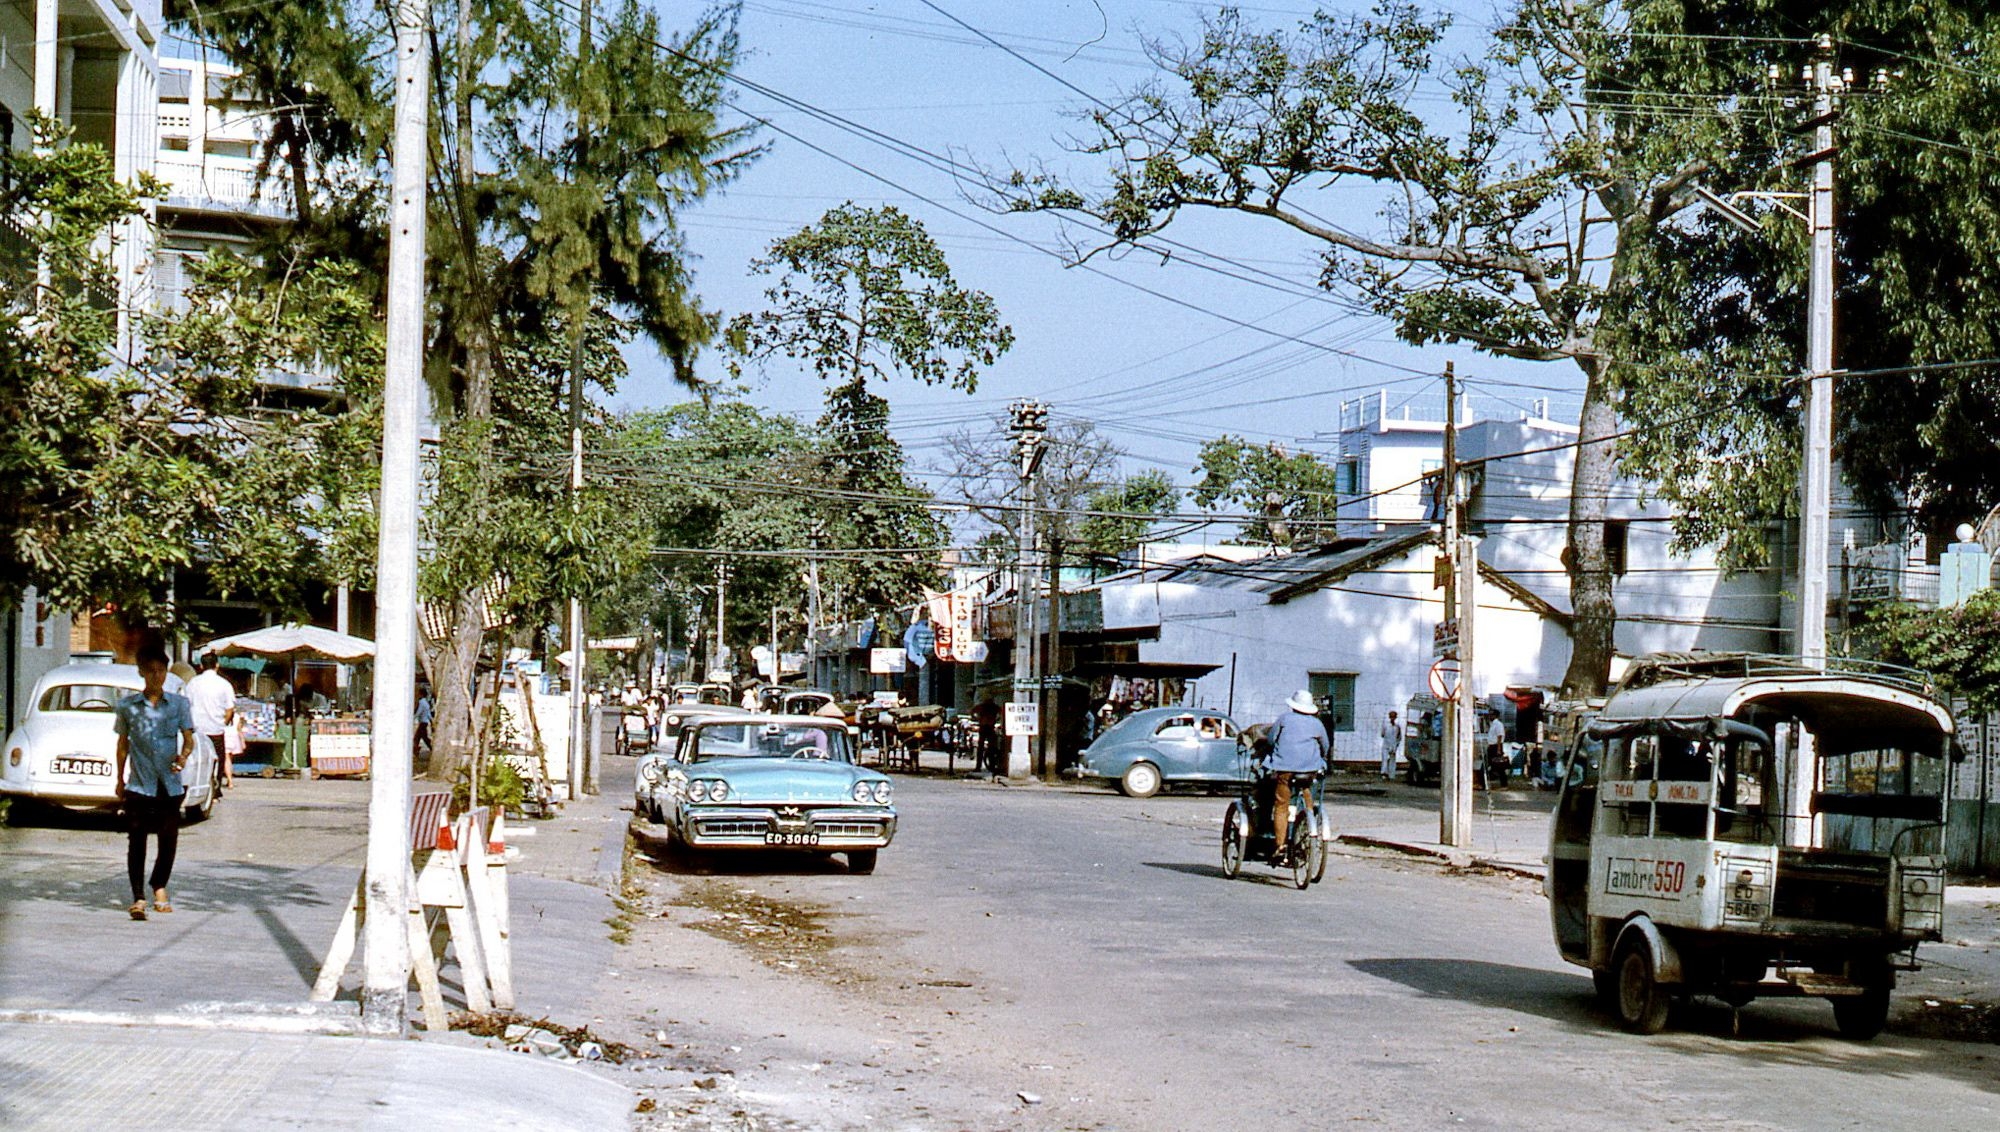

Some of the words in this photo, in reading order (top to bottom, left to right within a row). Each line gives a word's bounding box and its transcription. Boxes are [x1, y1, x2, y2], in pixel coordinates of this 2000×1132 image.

[1017, 705, 1036, 713] ENTRY
[1653, 860, 1686, 893] 550
[1734, 884, 1753, 899] ED
